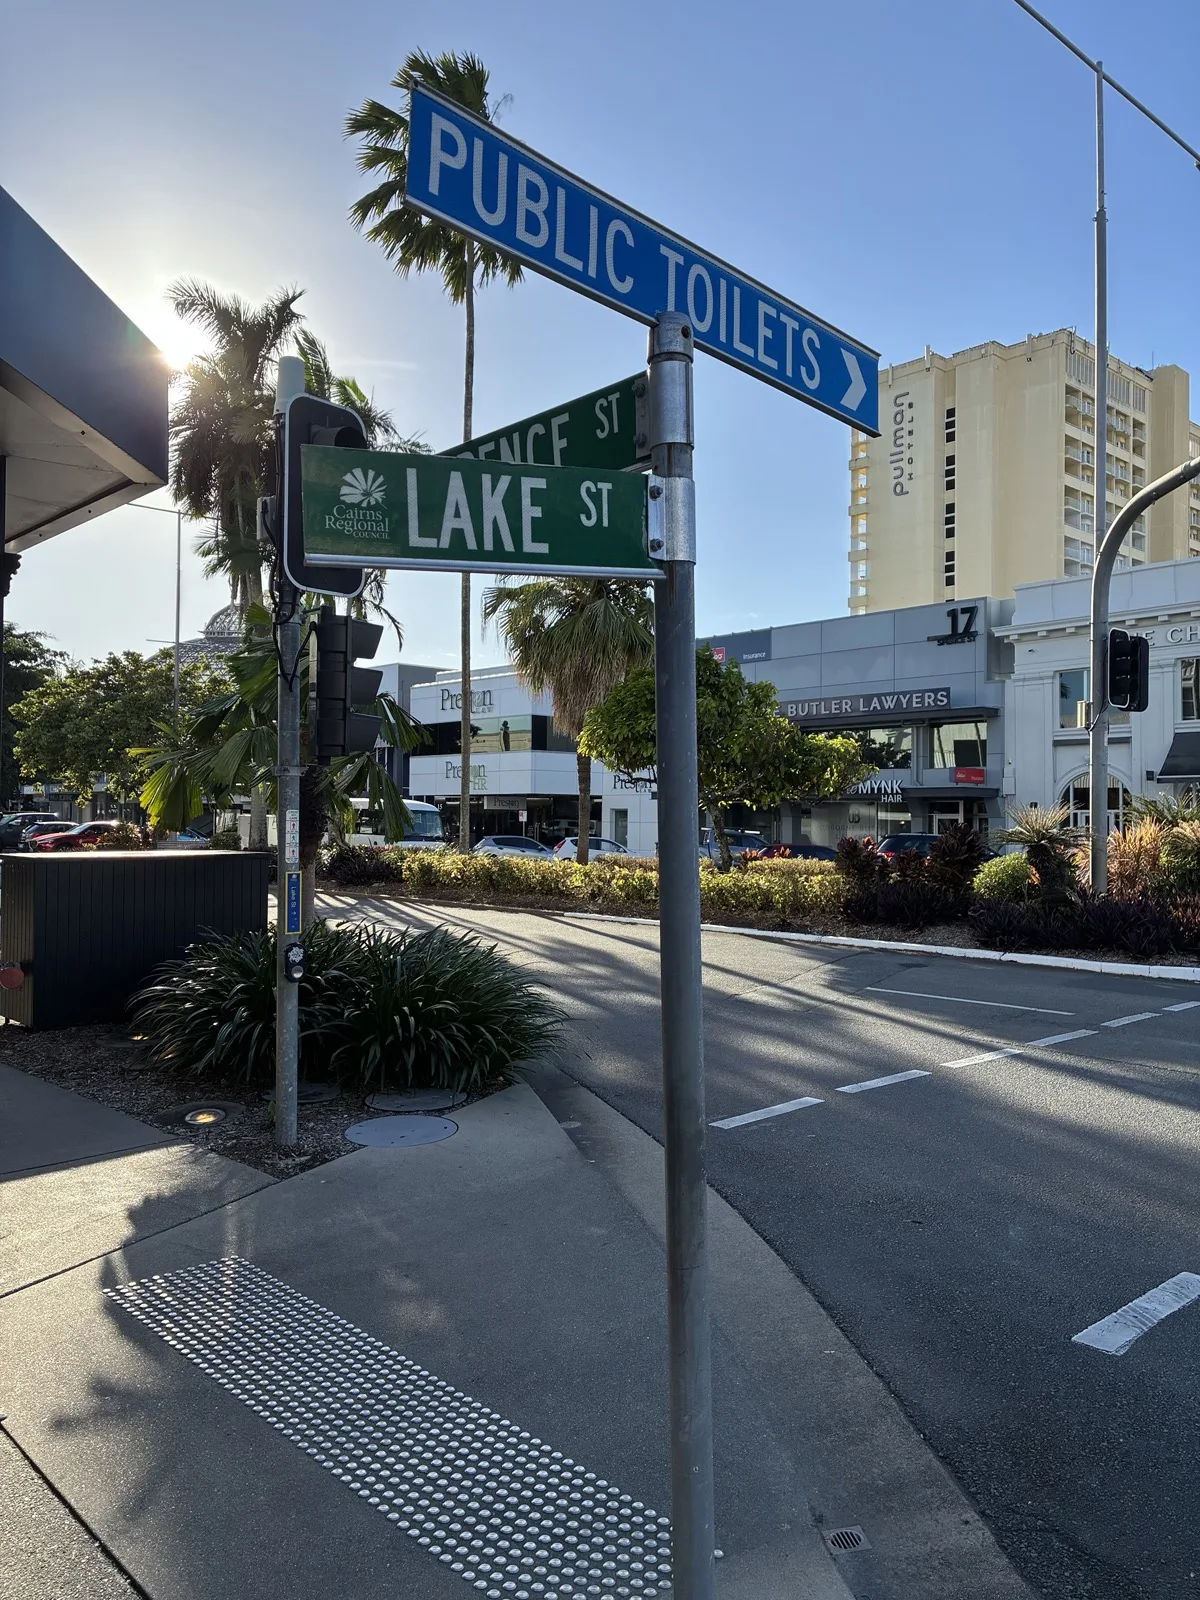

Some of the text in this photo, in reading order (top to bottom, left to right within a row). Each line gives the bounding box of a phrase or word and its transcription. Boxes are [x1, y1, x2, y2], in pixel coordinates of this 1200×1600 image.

[428, 112, 822, 391] PUBLIC TOILETS
[595, 391, 621, 439] ST
[889, 391, 910, 497] pullman
[333, 504, 383, 520] Cairns
[406, 467, 613, 554] LAKE ST
[324, 515, 389, 534] Regional
[353, 530, 390, 540] COUNCIL
[946, 605, 979, 636] 17
[743, 652, 766, 660] Insurance
[787, 699, 853, 717] BUTLER
[859, 691, 948, 712] LAWYERS
[473, 778, 488, 790] HR
[881, 794, 903, 803] HAIR
